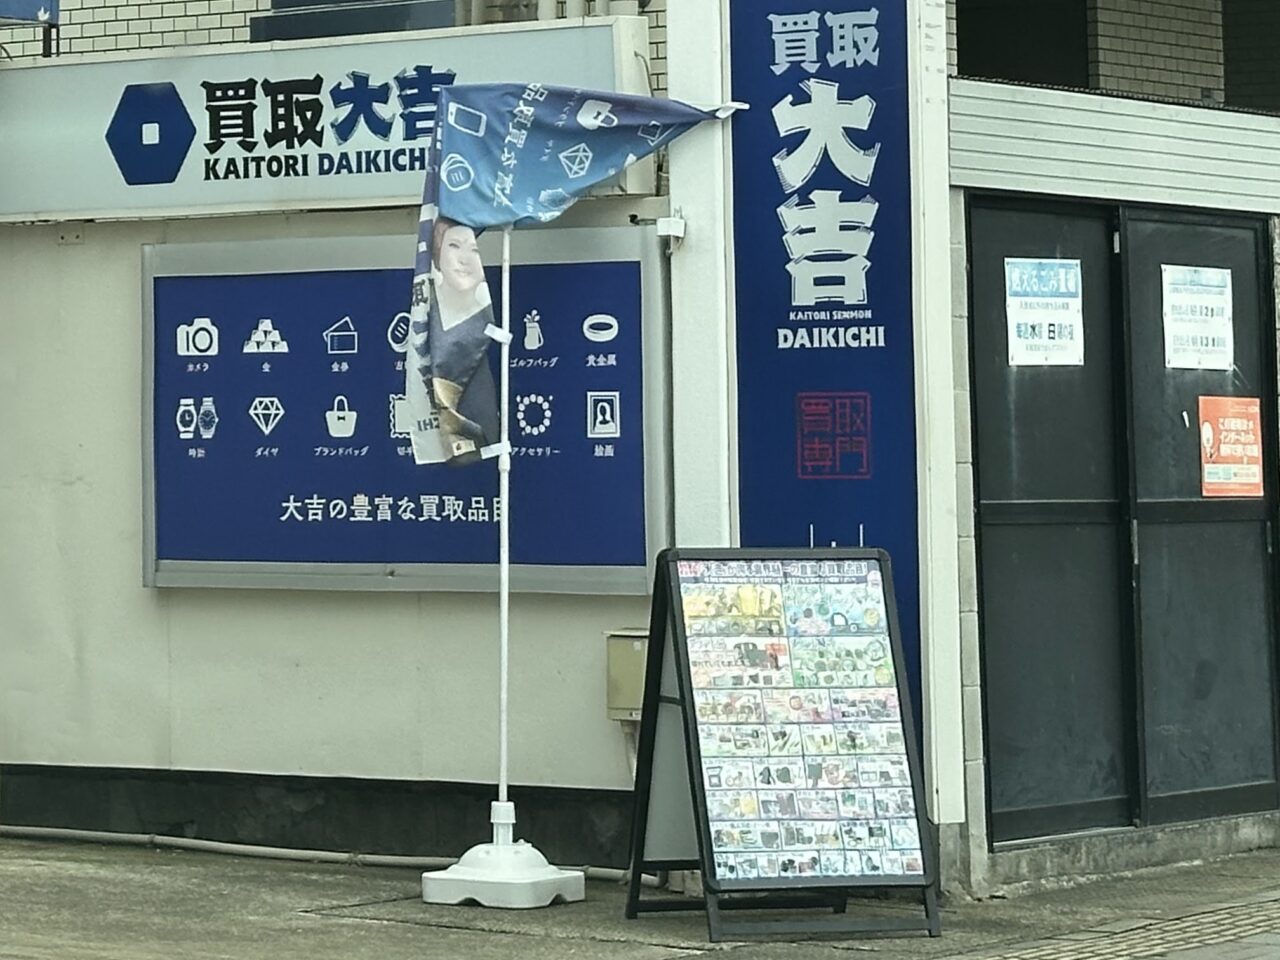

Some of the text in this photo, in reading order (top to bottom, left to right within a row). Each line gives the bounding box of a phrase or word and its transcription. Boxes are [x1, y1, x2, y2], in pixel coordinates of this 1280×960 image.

[767, 7, 880, 76] 買取
[201, 65, 456, 152] 買取大吉
[204, 147, 427, 181] KAITORI DAIKICH
[771, 77, 881, 306] 大吉
[777, 326, 886, 349] DAIKICHI
[789, 311, 830, 321] KAITORI
